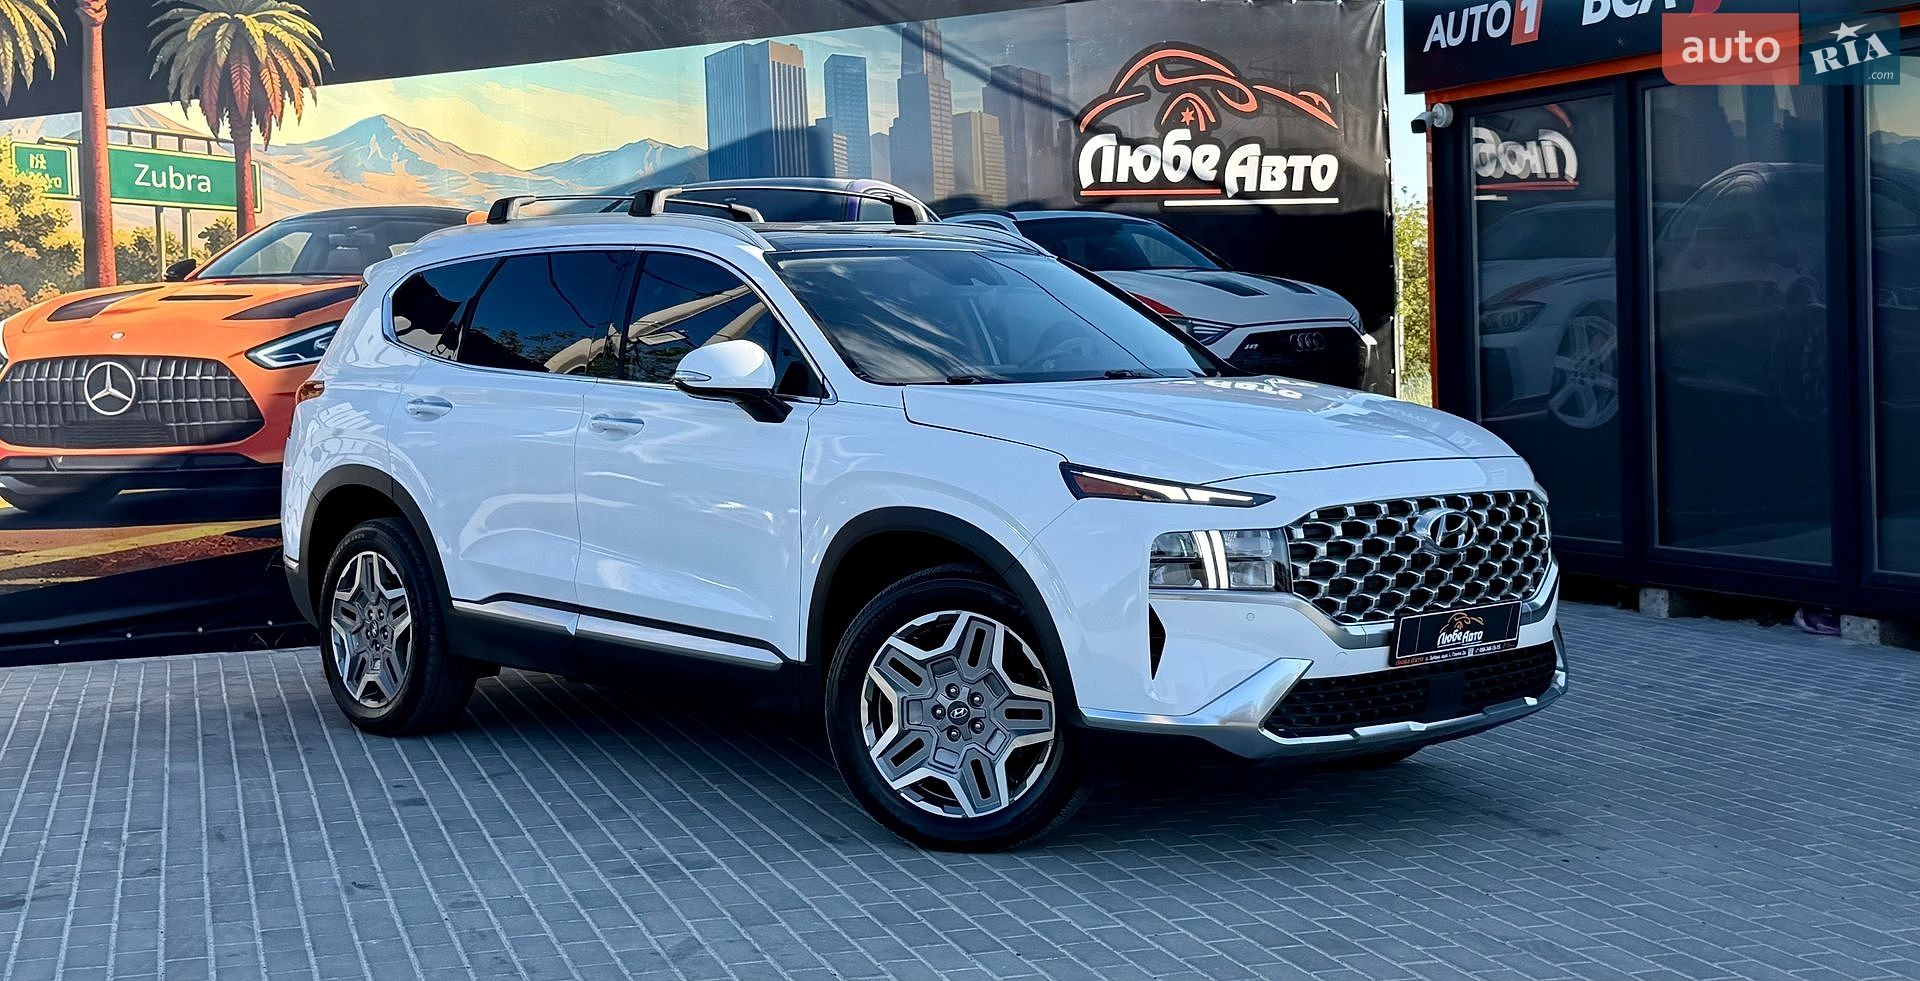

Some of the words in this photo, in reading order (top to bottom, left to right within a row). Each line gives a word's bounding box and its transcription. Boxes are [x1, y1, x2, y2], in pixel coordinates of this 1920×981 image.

[133, 163, 212, 193] Zubra
[1078, 128, 1222, 190] Любе
[1224, 143, 1340, 198] Авто
